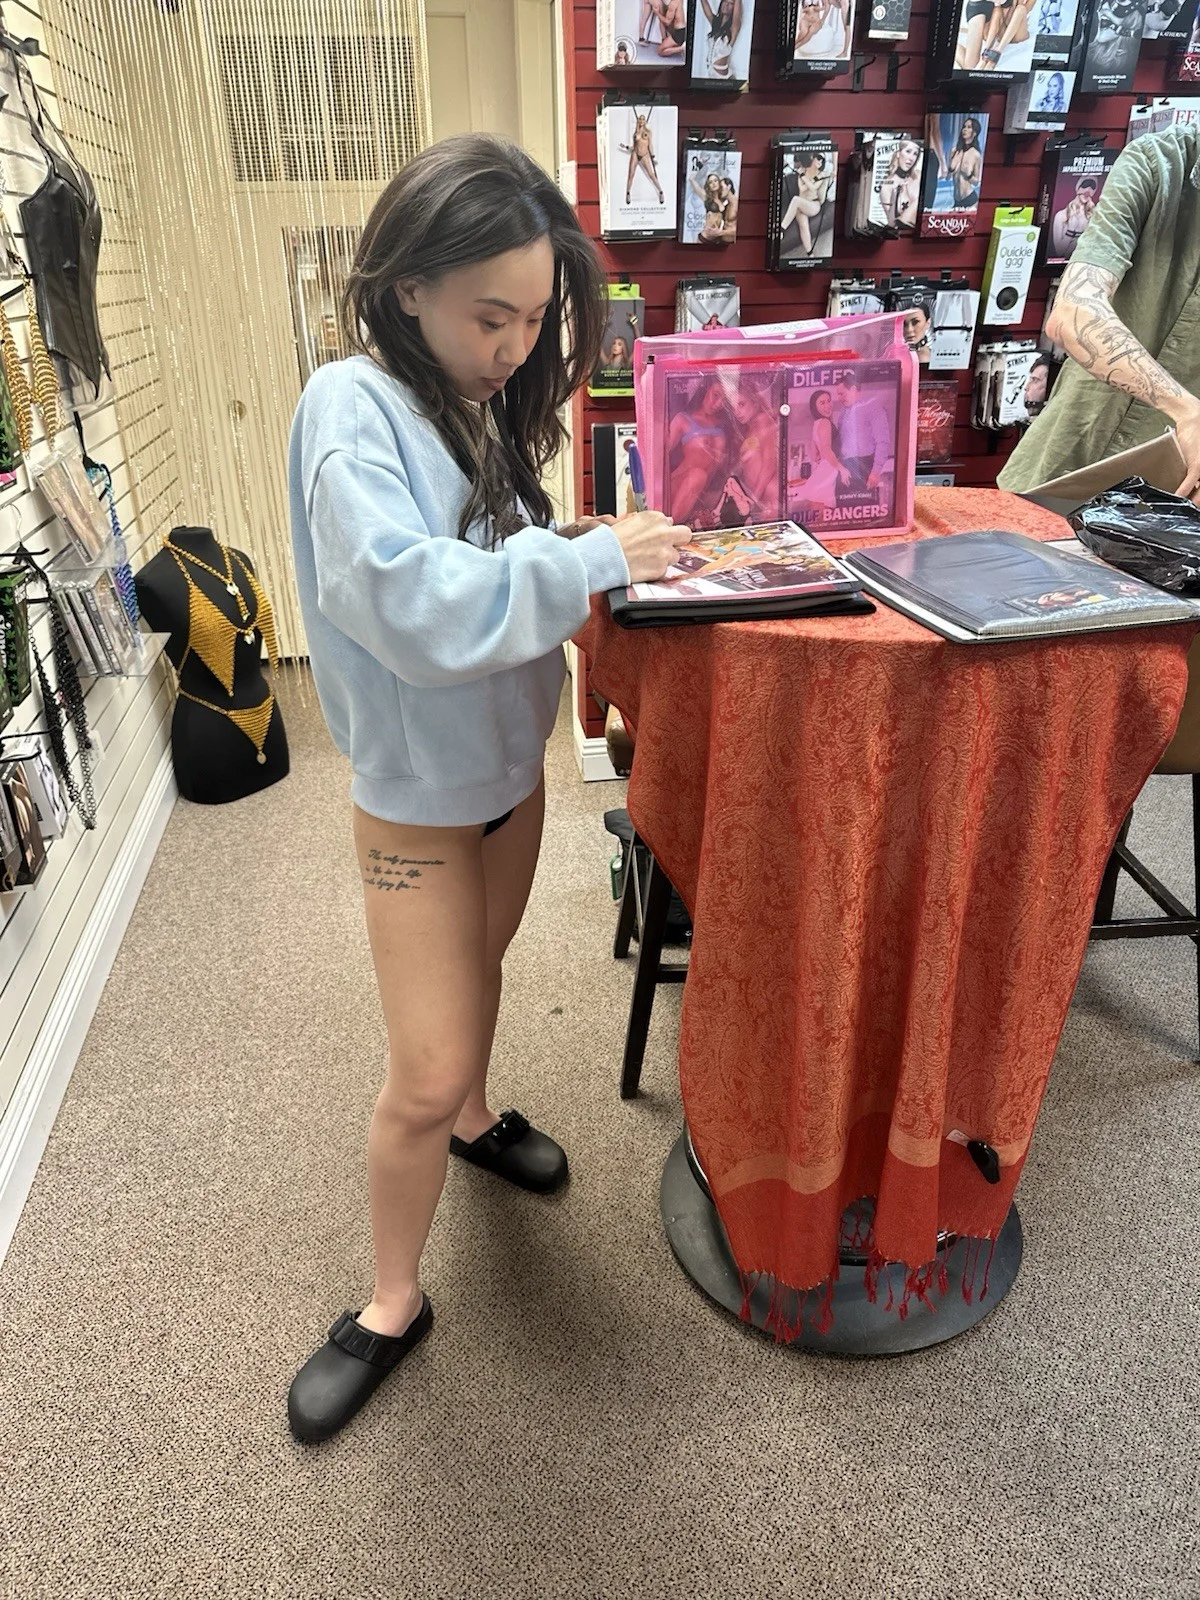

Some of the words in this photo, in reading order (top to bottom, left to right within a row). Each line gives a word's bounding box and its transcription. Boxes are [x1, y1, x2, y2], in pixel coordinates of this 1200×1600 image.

[876, 143, 899, 156] STRICT
[1073, 156, 1105, 166] PREMIUM
[928, 216, 969, 236] SCANDAL
[1000, 246, 1033, 258] Quickie
[1005, 257, 1024, 269] gag
[840, 296, 861, 308] STRICT
[1007, 355, 1027, 367] STRICT
[793, 371, 830, 387] DILF
[823, 504, 889, 521] BANGERS
[368, 849, 381, 860] The
